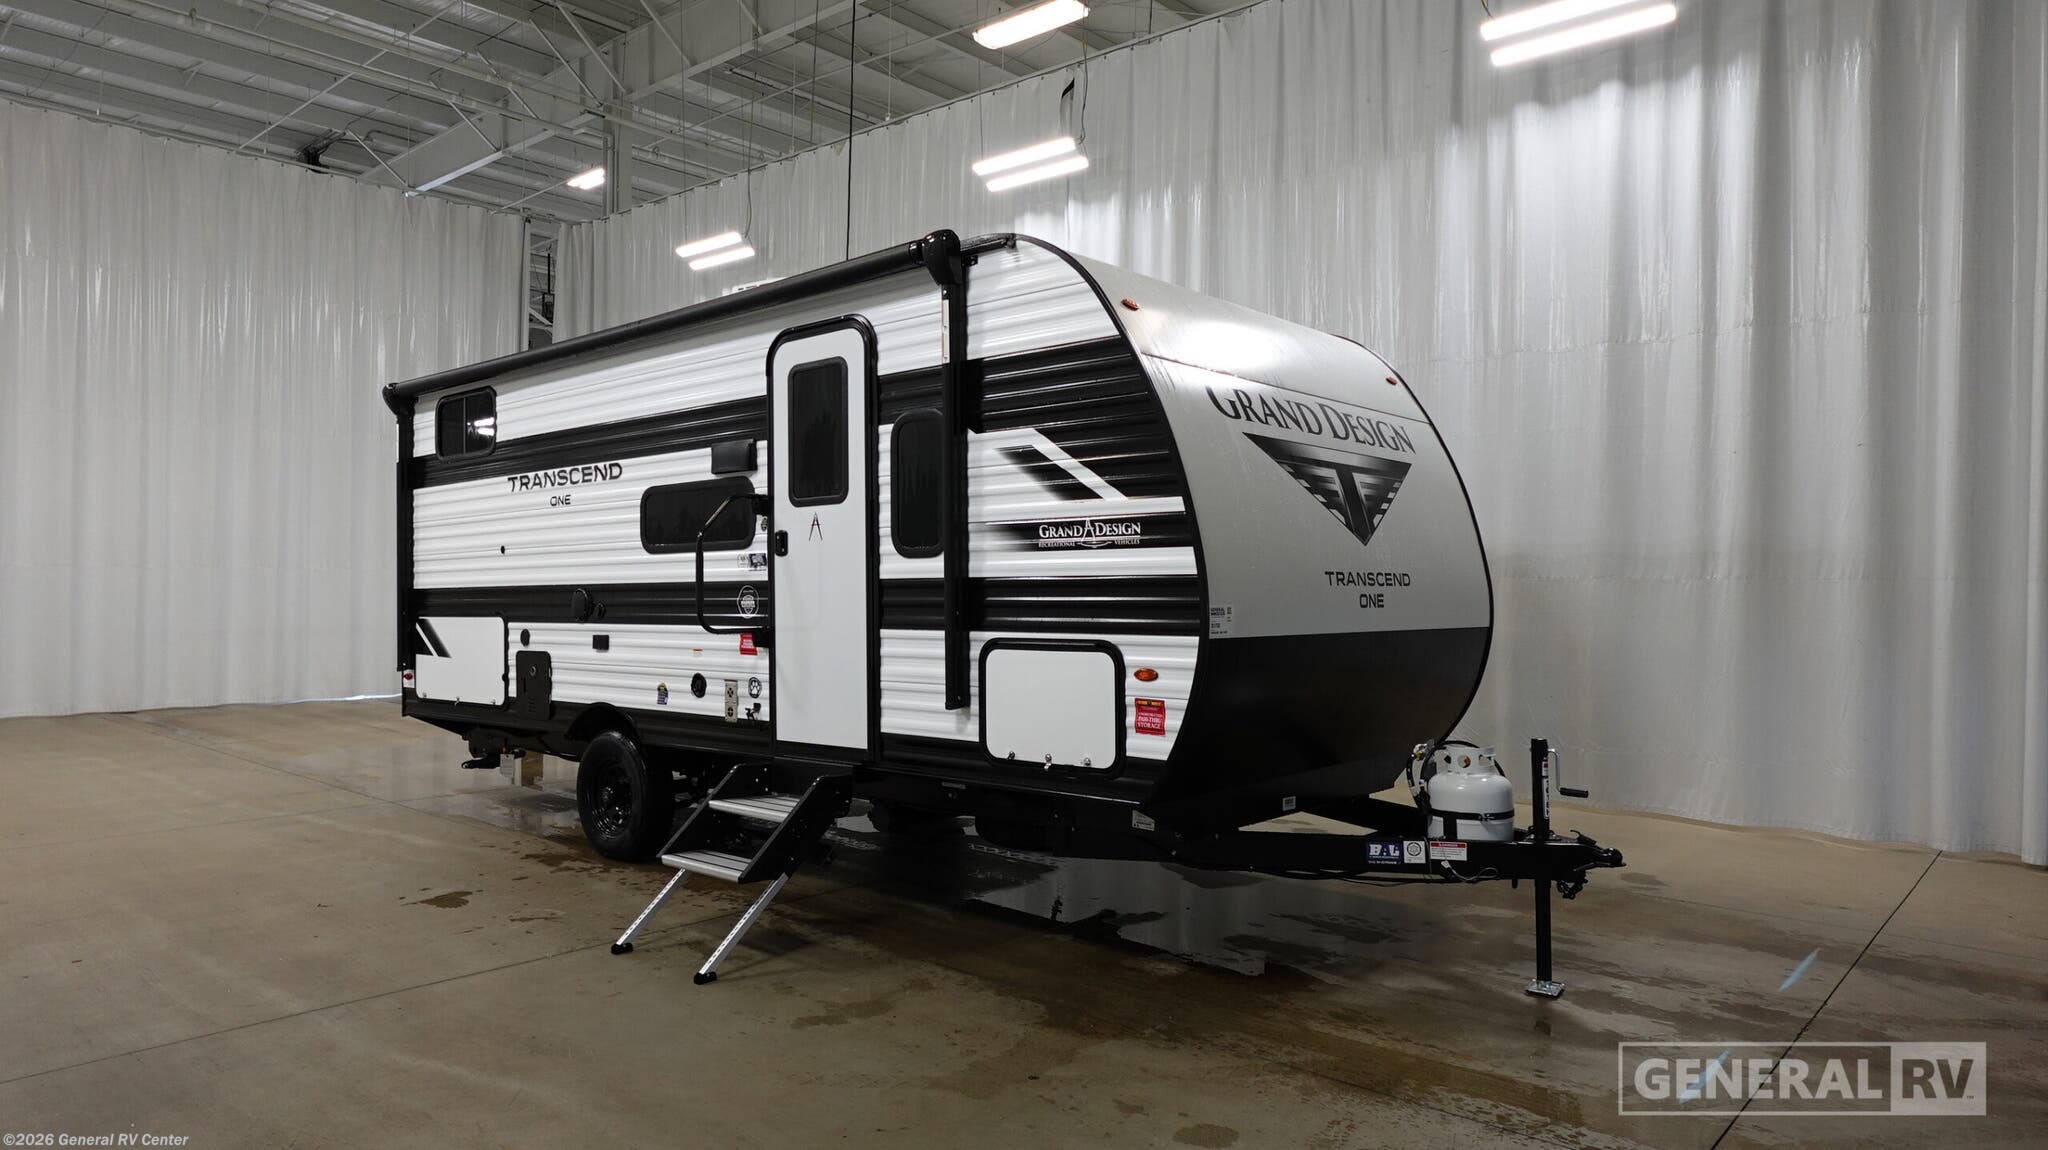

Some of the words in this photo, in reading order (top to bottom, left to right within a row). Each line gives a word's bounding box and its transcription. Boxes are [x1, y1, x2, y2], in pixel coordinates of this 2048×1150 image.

[1206, 385, 1323, 436] GRAND
[1316, 402, 1416, 455] DESIGN
[507, 462, 623, 492] TRANSCEND
[550, 494, 571, 507] ONE
[1038, 524, 1083, 538] GRAND
[1094, 522, 1141, 536] DESIGN
[1324, 571, 1411, 587] TRANSCEND
[1359, 593, 1385, 609] ONE
